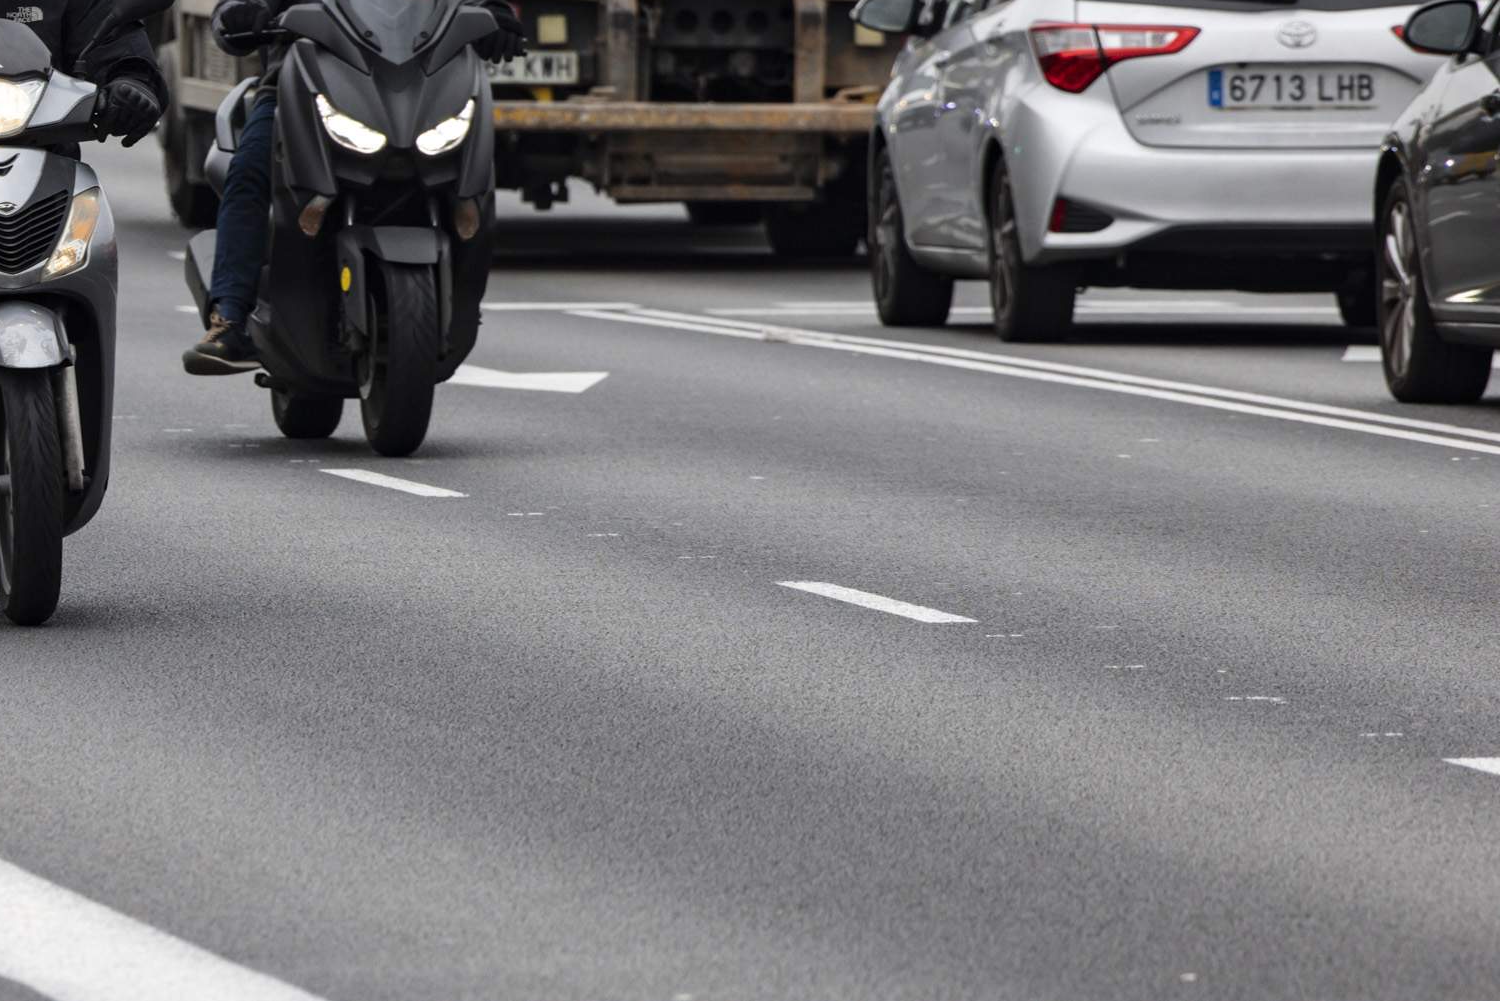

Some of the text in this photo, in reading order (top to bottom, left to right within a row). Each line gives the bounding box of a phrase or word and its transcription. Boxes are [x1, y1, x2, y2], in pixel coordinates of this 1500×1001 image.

[6, 11, 32, 19] NORTH
[1230, 73, 1375, 102] 6713 LHB
